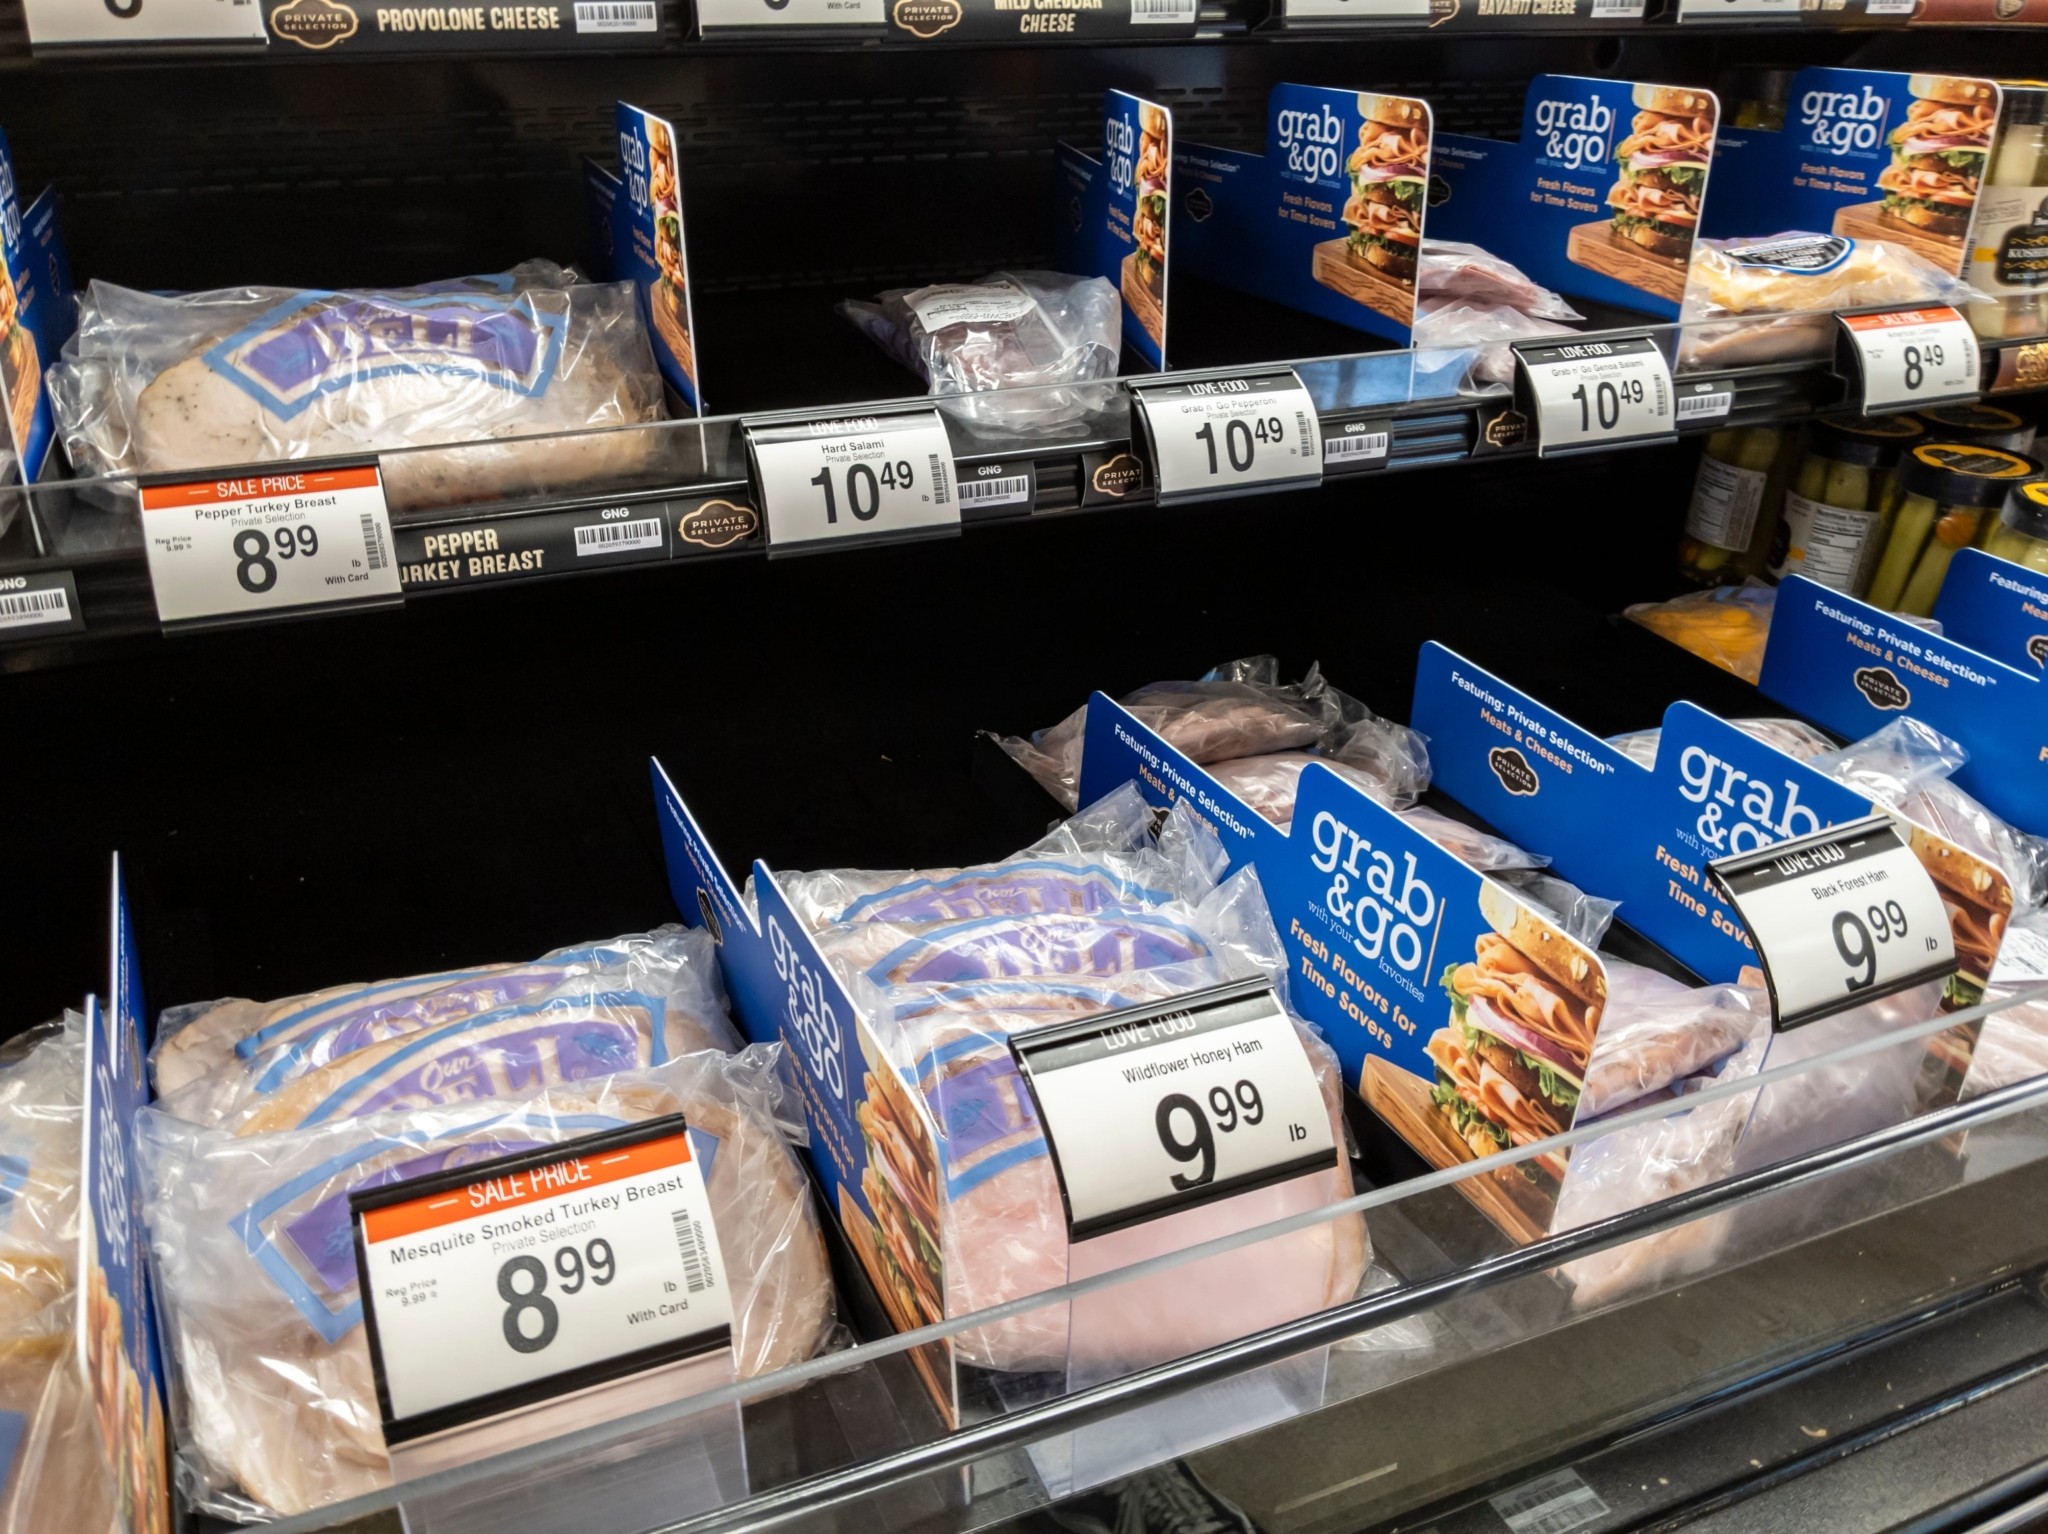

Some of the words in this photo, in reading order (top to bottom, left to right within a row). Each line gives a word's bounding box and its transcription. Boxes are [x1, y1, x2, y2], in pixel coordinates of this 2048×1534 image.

[284, 13, 343, 23] PRIVATE
[377, 8, 485, 32] PROVOLONE
[490, 7, 560, 30] CHEESE
[904, 6, 951, 14] PRIVATE
[1020, 13, 1077, 33] CHEESE
[283, 21, 348, 31] SELECTION
[1536, 95, 1611, 136] grab
[1801, 86, 1885, 125] grab
[1106, 113, 1134, 158] grab
[1278, 104, 1341, 148] grab
[1812, 120, 1877, 156] &go
[620, 126, 645, 174] grab
[1288, 142, 1338, 184] &go
[1546, 131, 1605, 170] &go
[1111, 152, 1132, 195] &go
[1537, 177, 1561, 191] Fresh
[1562, 181, 1596, 197] Flavors
[1283, 192, 1303, 205] Fresh
[1304, 196, 1333, 213] Flavors
[1544, 193, 1565, 207] Time
[1566, 197, 1599, 213] Savers
[1290, 209, 1308, 224] Time
[1309, 213, 1336, 230] Savers
[1558, 346, 1588, 359] LOVE
[1587, 343, 1613, 356] FOOD
[1186, 381, 1218, 396] LOVE
[1218, 379, 1250, 393] FOOD
[1216, 401, 1230, 410] Go
[1231, 398, 1278, 409] Pepperoni
[807, 419, 843, 436] LOVE
[843, 417, 879, 431] FOOD
[1345, 423, 1366, 433] GNG
[821, 443, 848, 455] Hard
[849, 439, 885, 452] Salami
[825, 454, 851, 463] Private
[853, 450, 886, 461] Selection
[977, 465, 1002, 476] GNG
[1104, 469, 1141, 480] PRIVAT
[216, 480, 258, 498] SALE
[261, 475, 306, 493] PRICE
[195, 506, 243, 521] Pepper
[245, 499, 292, 515] Turkey
[294, 496, 337, 509] Breast
[231, 517, 263, 527] Private
[265, 511, 306, 524] Selection
[601, 507, 630, 519] GNG
[692, 516, 746, 529] PRIVATE
[155, 537, 172, 546] Reg
[172, 535, 193, 543] Price
[424, 528, 500, 558] PEPPER
[690, 523, 749, 536] SELECTION
[351, 559, 362, 568] lb
[469, 549, 544, 577] BREAST
[324, 575, 347, 585] With
[347, 573, 369, 583] Card
[1815, 601, 1874, 637] Featuring:
[1877, 628, 1921, 657] Private
[1846, 632, 1883, 658] Meats
[1884, 650, 1894, 662] &
[1897, 655, 1950, 688] Cheeses
[1863, 674, 1902, 696] PRIVATE
[1451, 671, 1505, 713] Featuring:
[1507, 704, 1547, 738] Private
[1480, 708, 1512, 737] Meats
[1514, 729, 1523, 743] &
[1525, 736, 1573, 775] Cheeses
[1114, 723, 1161, 769] Featuring:
[1162, 761, 1196, 798] Private
[1497, 754, 1531, 782] PRIVATE
[1139, 764, 1166, 795] Meats
[1168, 788, 1175, 803] &
[1494, 761, 1532, 789] SELECTION
[1679, 745, 1821, 839] grab
[1676, 828, 1699, 850] with
[1311, 811, 1435, 927] grab
[1655, 845, 1699, 886] Fresh
[1775, 853, 1810, 876] LOVE
[1807, 843, 1846, 867] FOOD
[1811, 880, 1839, 900] Black
[1839, 875, 1867, 892] Forest
[1867, 869, 1889, 883] Ham
[1308, 901, 1329, 925] with
[1330, 920, 1354, 944] your
[1326, 873, 1422, 971] &go
[1668, 880, 1707, 918] Time
[1711, 910, 1755, 950] Save
[1926, 936, 1938, 952] lb
[768, 914, 840, 1054] grab
[1290, 918, 1329, 963] Fresh
[1332, 953, 1389, 1015] Flavors
[1393, 1004, 1417, 1037] for
[1378, 956, 1425, 1003] favorites
[1302, 956, 1336, 999] Time
[1339, 991, 1392, 1049] Savers
[788, 982, 844, 1100] &go
[1100, 1021, 1151, 1051] LOVE
[1149, 1010, 1198, 1040] FOOD
[1121, 1058, 1190, 1085] Wildflower
[1192, 1047, 1233, 1067] Honey
[1234, 1038, 1263, 1056] Ham
[1289, 1123, 1307, 1142] lb
[467, 1176, 525, 1209] SALE
[530, 1159, 593, 1193] PRICE
[390, 1230, 476, 1265] Mesquite
[482, 1209, 556, 1240] Smoked
[560, 1193, 621, 1221] Turkey
[626, 1176, 684, 1204] Breast
[492, 1235, 537, 1256] Private
[539, 1217, 597, 1244] Selection
[385, 1286, 408, 1300] Reg
[409, 1277, 438, 1292] Price
[401, 1293, 427, 1308] 9.99
[663, 1280, 678, 1294] lb
[626, 1308, 657, 1326] With
[658, 1299, 689, 1317] Card
